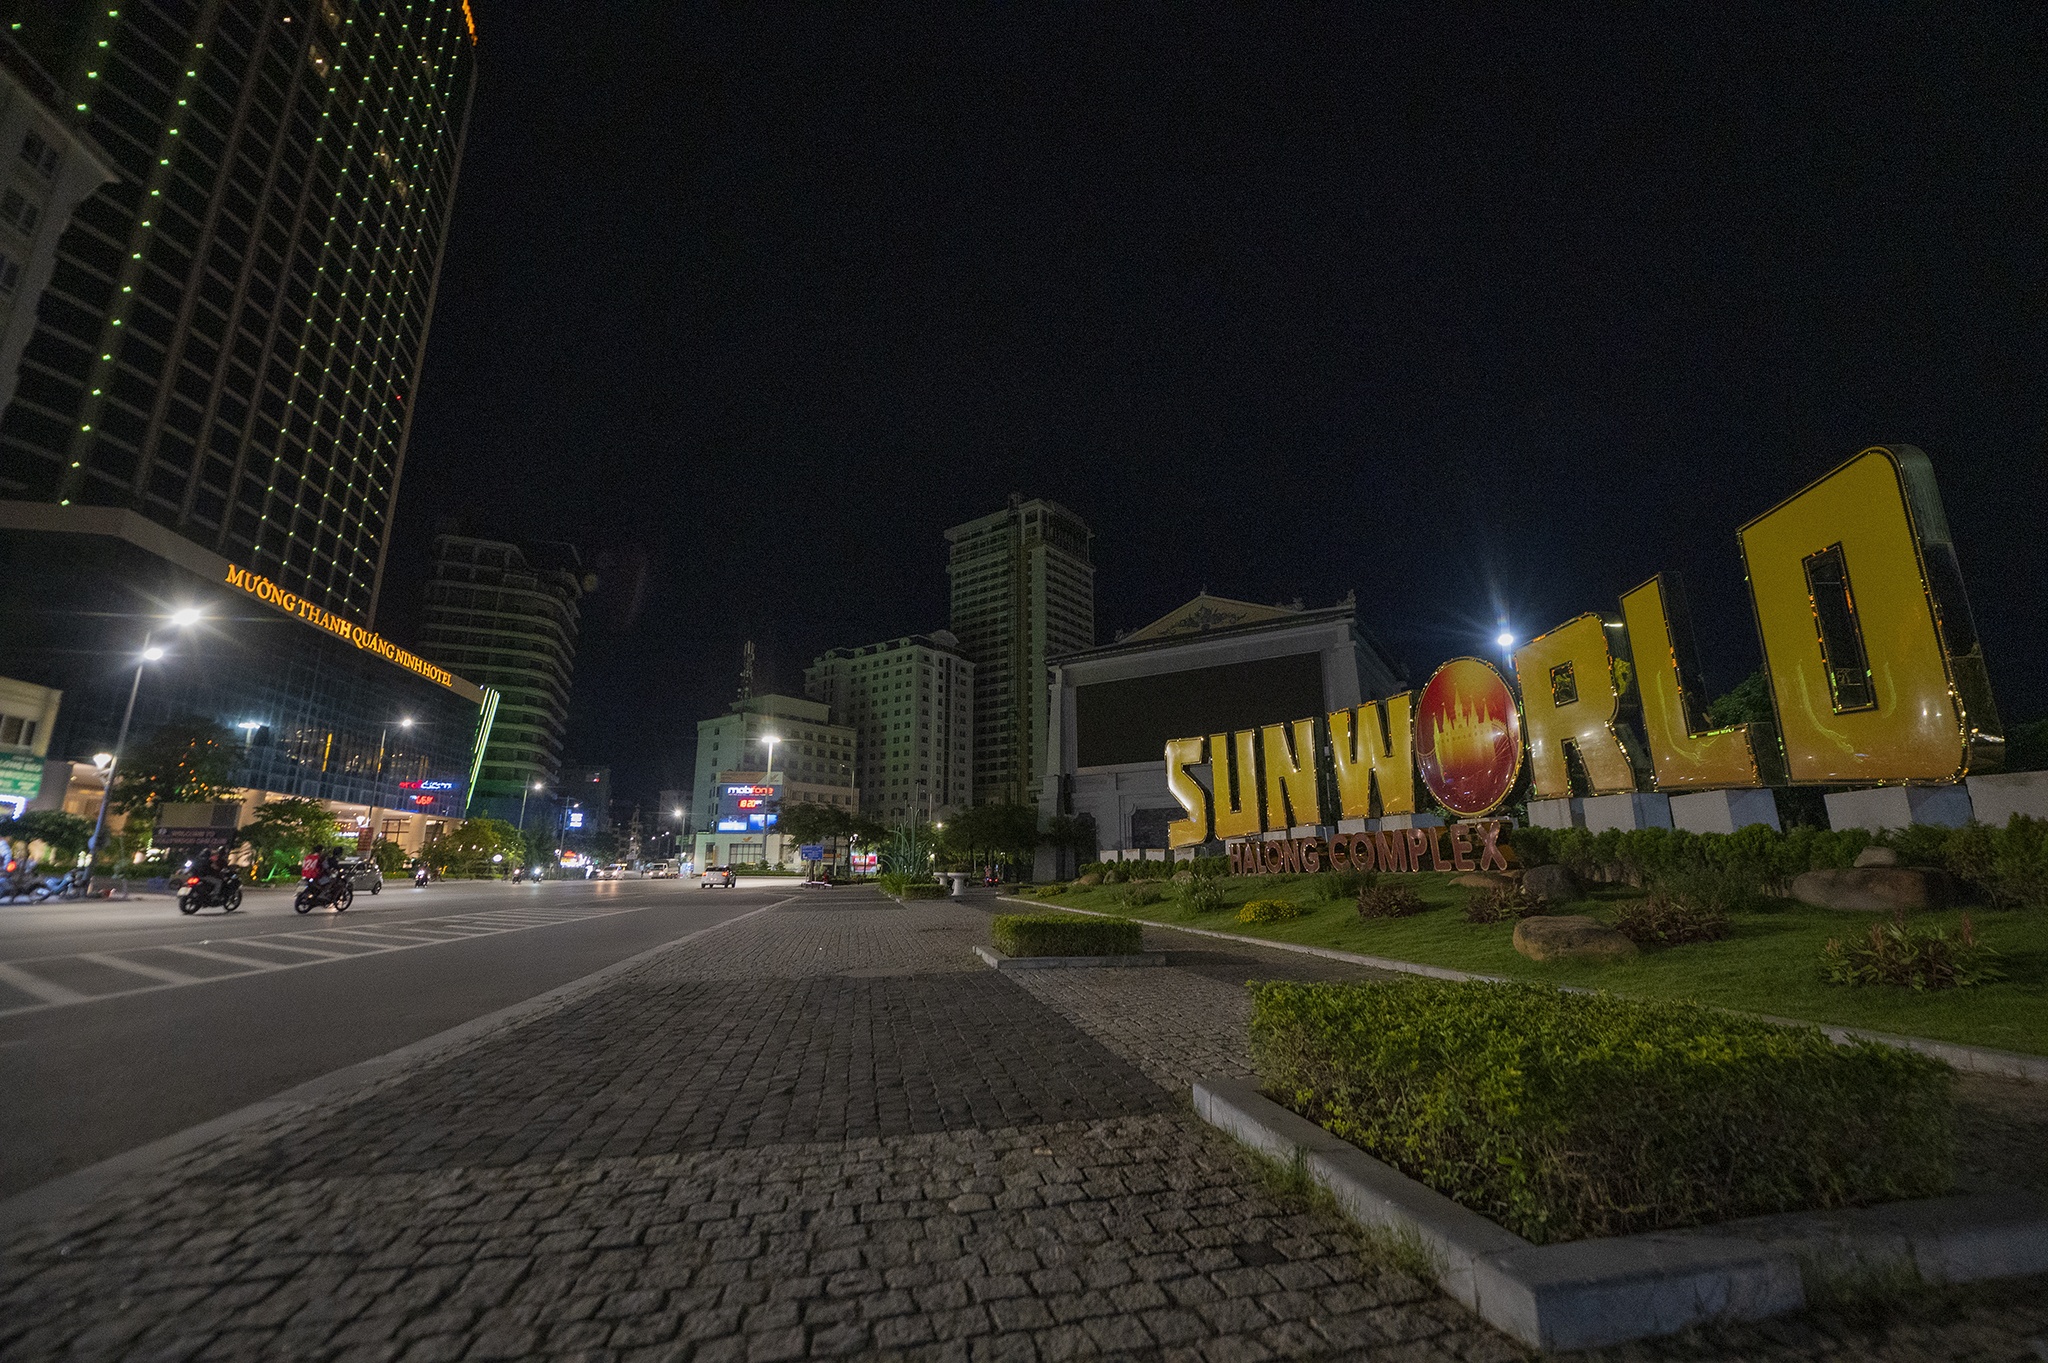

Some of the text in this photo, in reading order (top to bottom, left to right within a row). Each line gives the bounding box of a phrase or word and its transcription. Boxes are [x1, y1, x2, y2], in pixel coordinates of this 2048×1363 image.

[225, 564, 453, 687] MƯỜNG THANH QUẢNG NINH HOTEL
[728, 785, 774, 794] mobifone
[1229, 820, 1508, 874] HALONG COMPLEX
